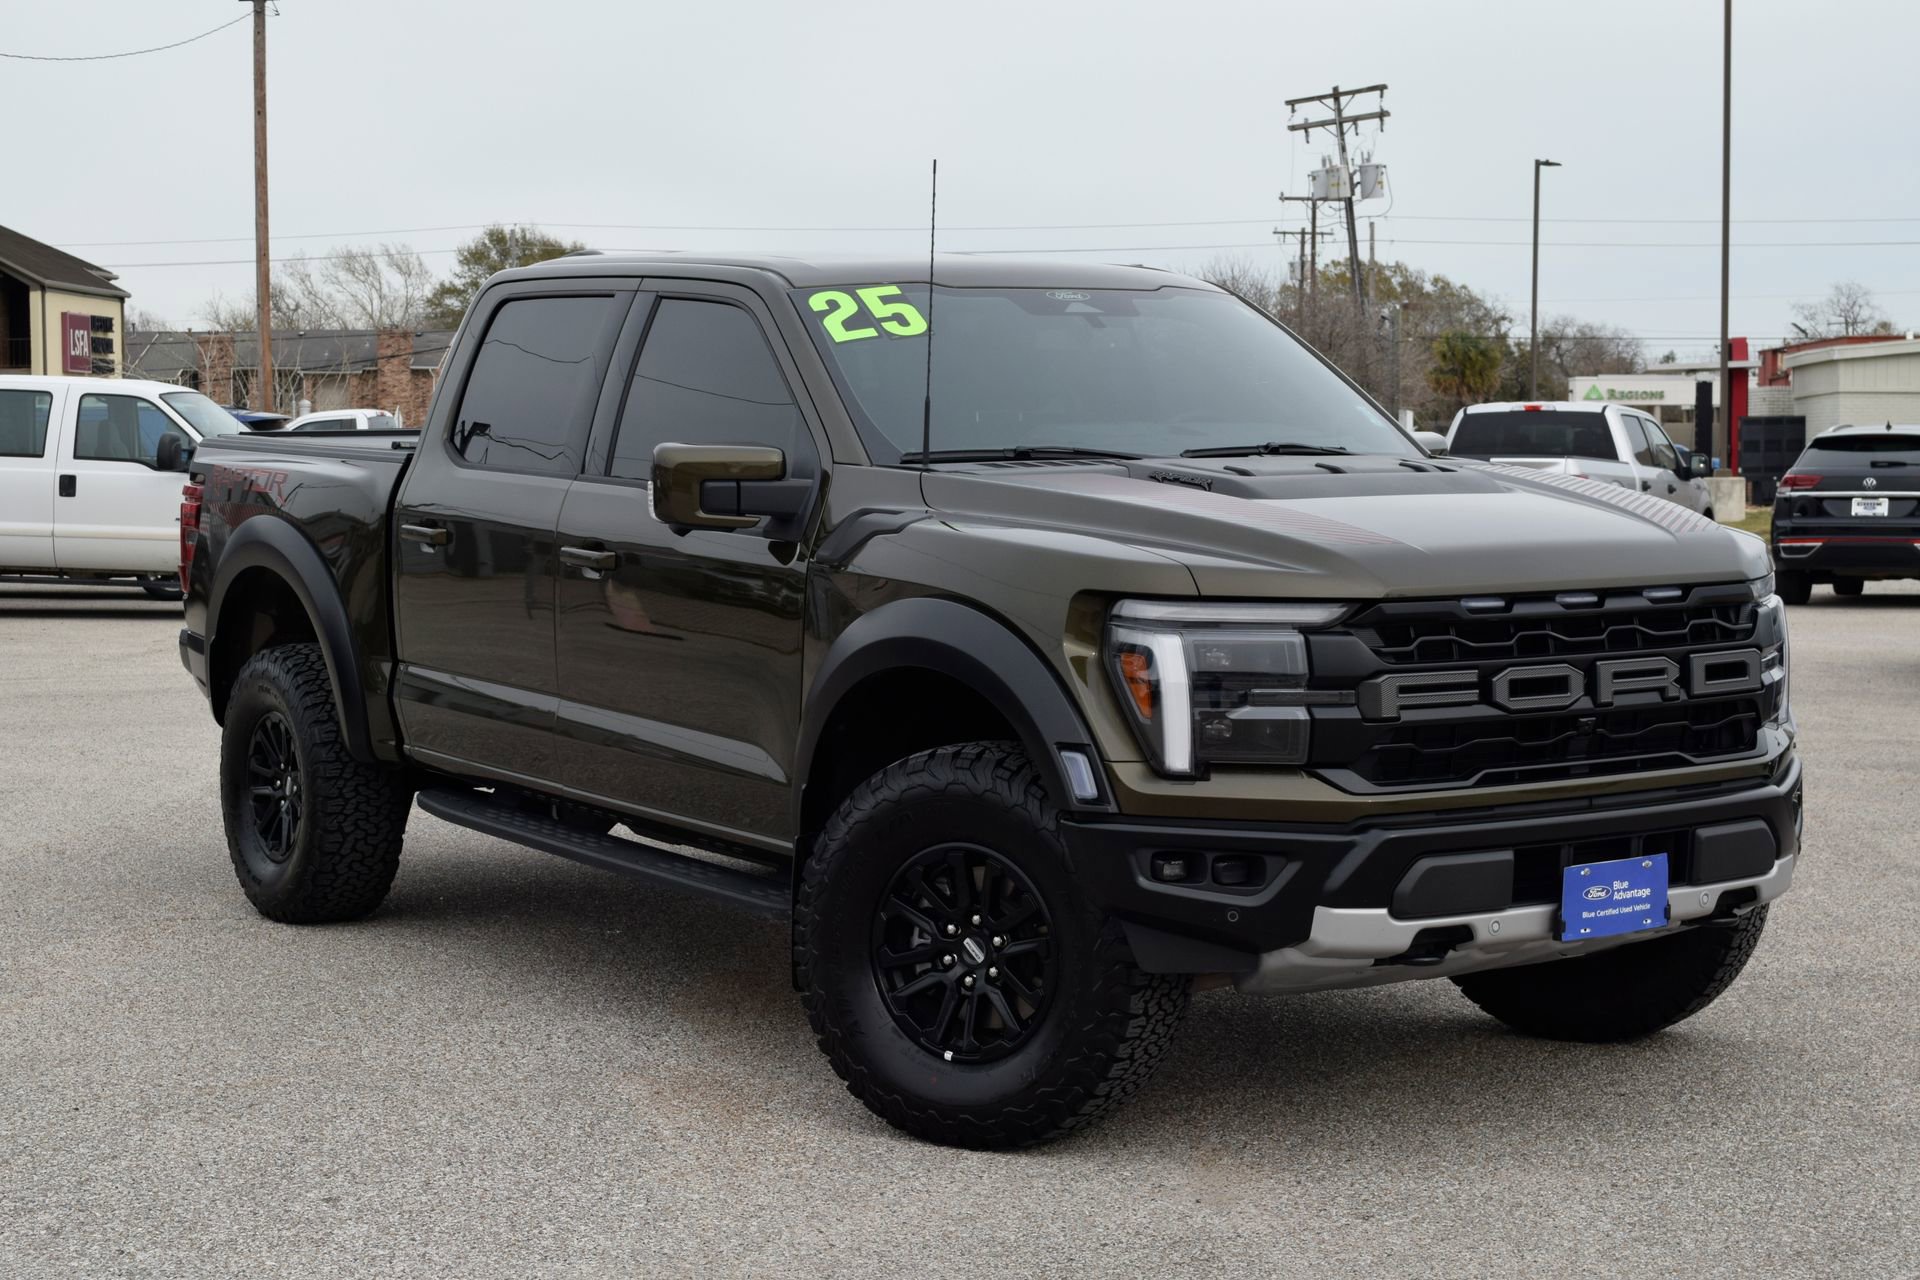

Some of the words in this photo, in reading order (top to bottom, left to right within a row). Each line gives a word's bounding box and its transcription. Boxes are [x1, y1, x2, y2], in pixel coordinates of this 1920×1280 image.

[808, 285, 928, 343] 25
[70, 329, 89, 357] LSFA
[1358, 648, 1762, 722] FORD
[1613, 880, 1629, 891] Blue
[1613, 888, 1651, 901] Advantage
[1582, 911, 1596, 919] Blue
[1596, 907, 1619, 917] Certified
[1620, 906, 1633, 914] Used
[1633, 903, 1651, 912] Vehicle
